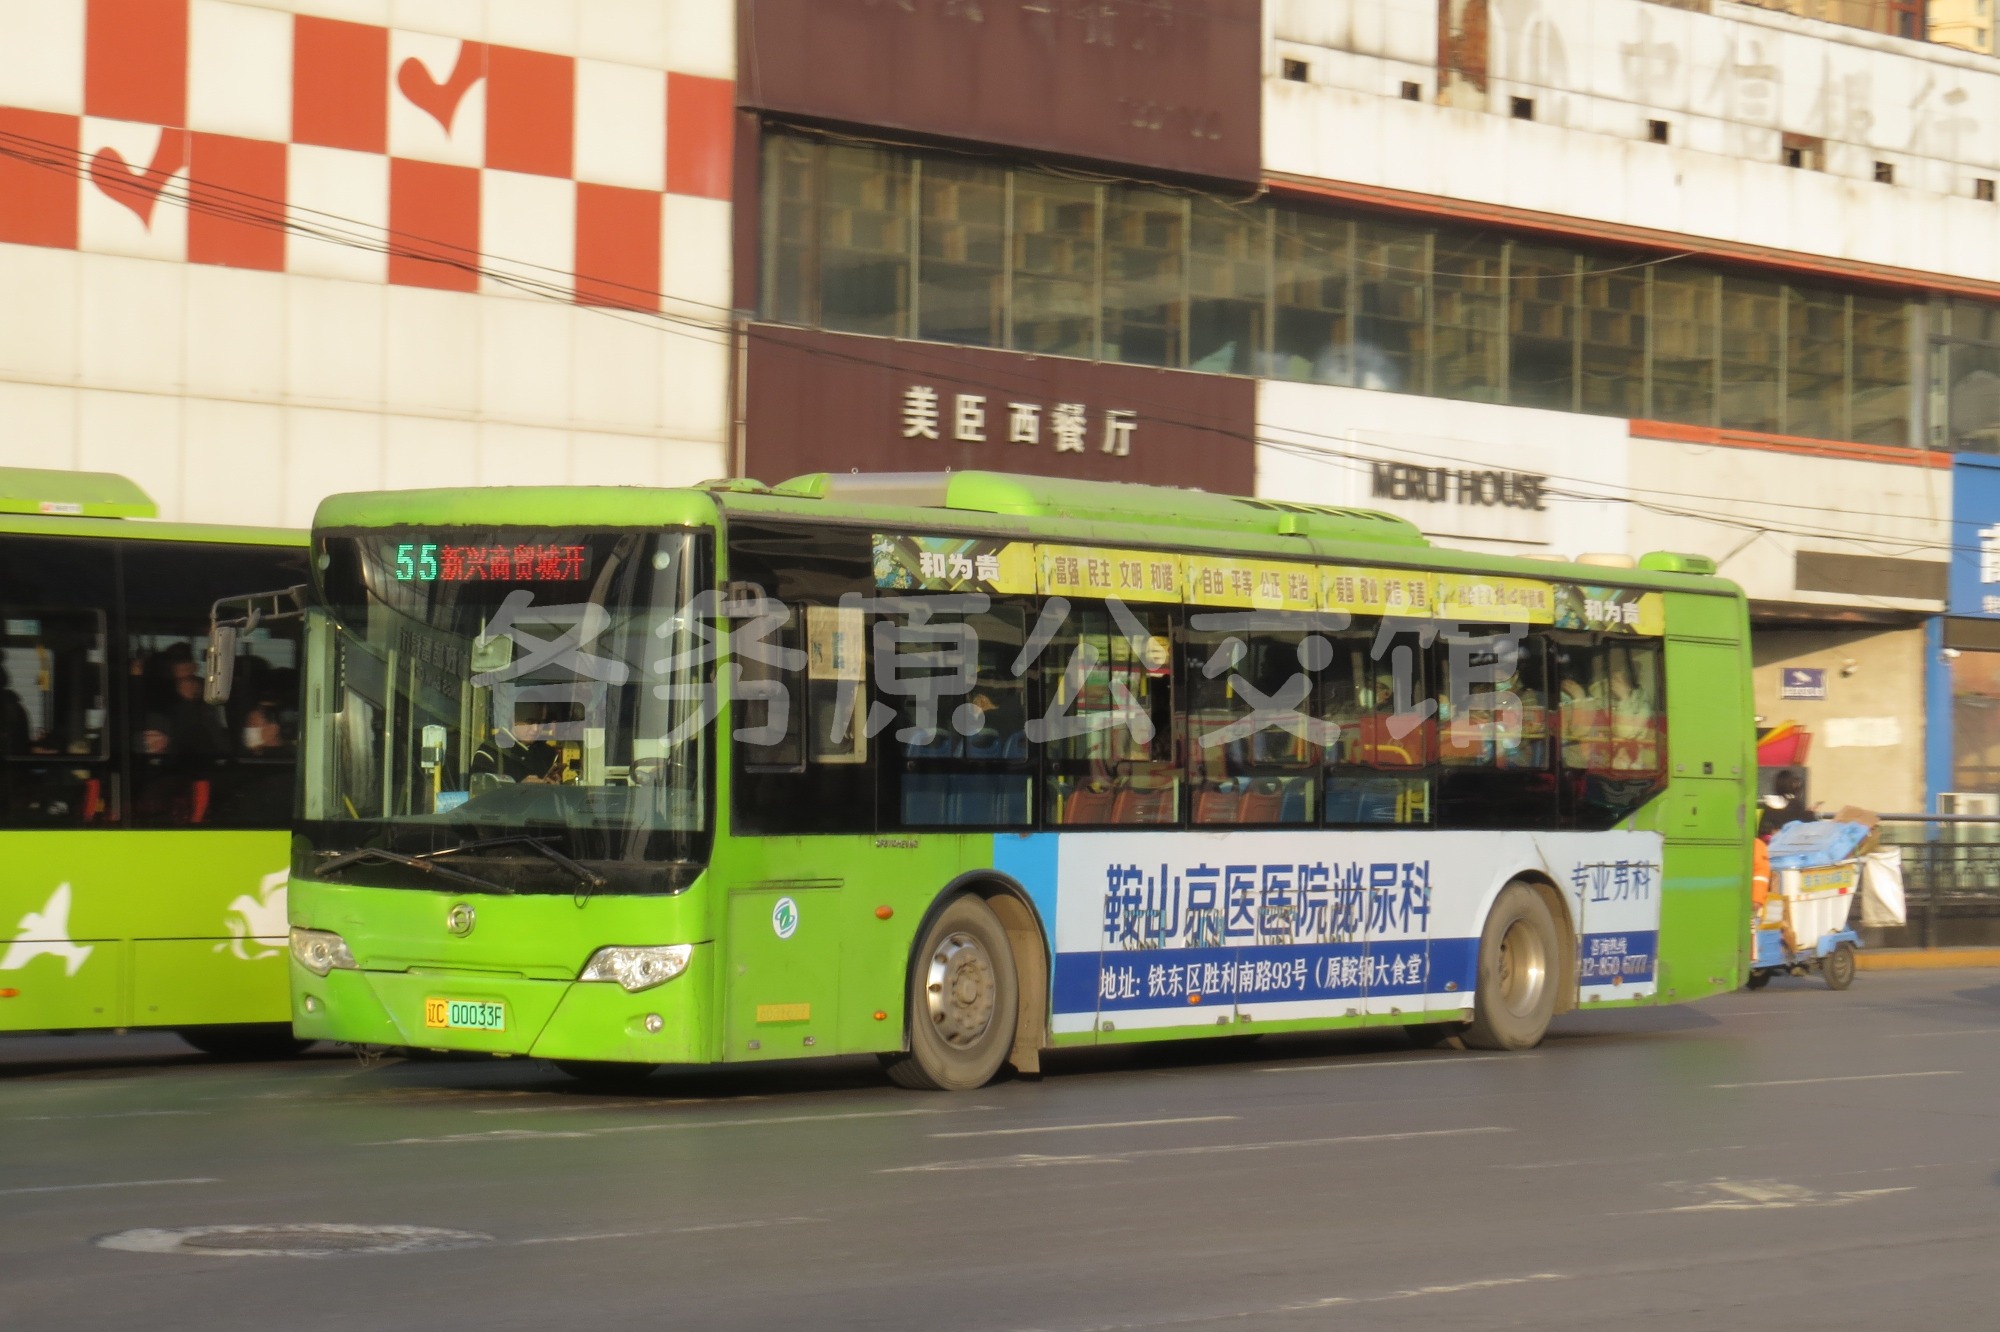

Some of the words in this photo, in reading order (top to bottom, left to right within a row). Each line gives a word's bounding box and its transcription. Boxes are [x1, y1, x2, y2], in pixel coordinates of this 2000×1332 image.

[902, 385, 1137, 456] 美臣西餐厅
[1458, 470, 1547, 512] HOUSE
[395, 544, 437, 580] 55
[440, 544, 586, 581] 新兴商贸城开
[919, 551, 1000, 582] 和为贵
[1054, 556, 1080, 587] 富强
[1088, 559, 1112, 588] 民主
[1120, 561, 1143, 589] 文明
[1150, 564, 1174, 591] 和谐
[1202, 566, 1225, 596] 自由
[1231, 569, 1253, 597] 平等
[1259, 572, 1282, 599] 公正
[1287, 573, 1310, 602] 法治
[1336, 576, 1355, 603] 爱国
[1360, 577, 1379, 605] 敬业
[1584, 600, 1640, 624] 和为贵
[1571, 860, 1652, 902] 专业男科
[1104, 860, 1431, 943] 鞍山京医医院泌尿科
[452, 1004, 502, 1026] 00033F
